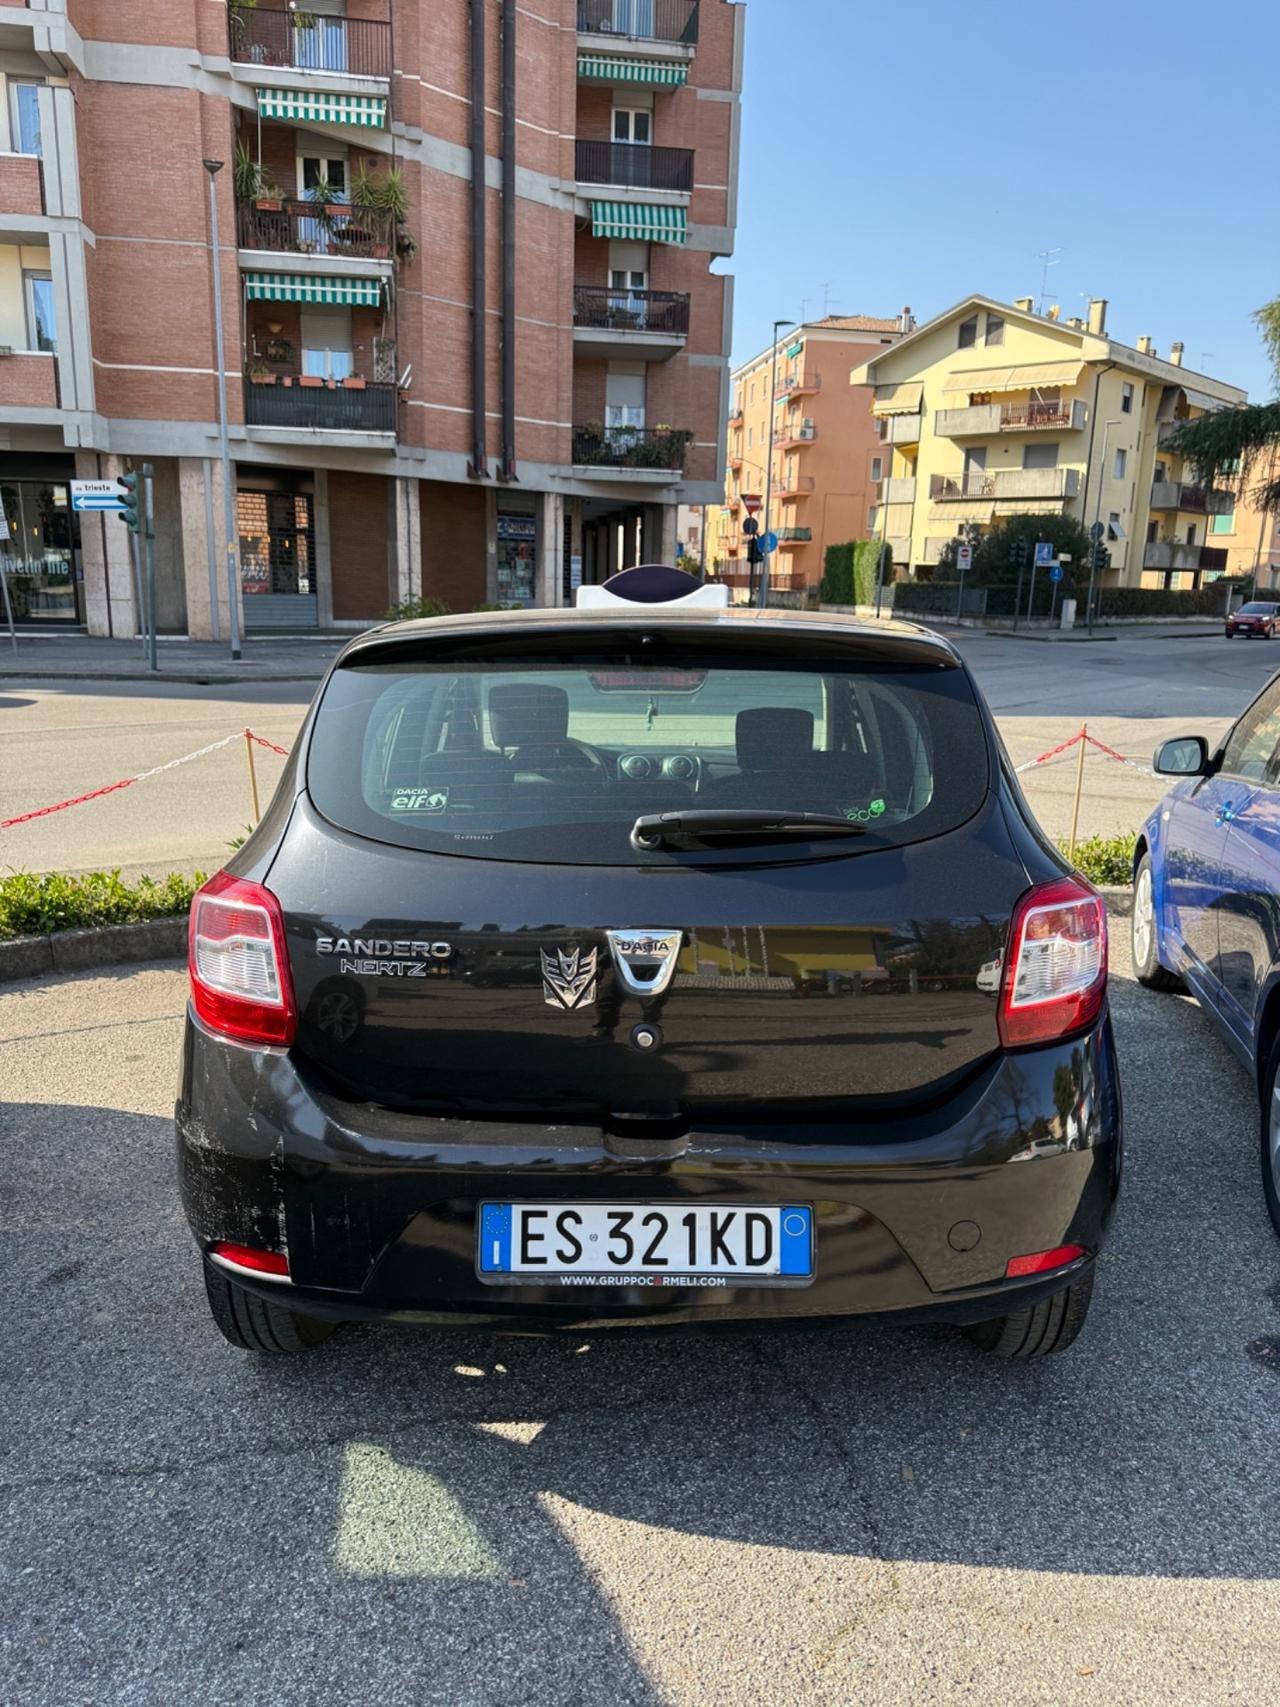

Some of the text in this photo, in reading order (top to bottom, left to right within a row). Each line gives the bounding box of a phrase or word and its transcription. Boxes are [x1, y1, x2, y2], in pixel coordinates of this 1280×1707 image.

[84, 484, 111, 492] trieste
[391, 795, 428, 809] elf
[316, 937, 452, 957] SANDERO
[621, 941, 669, 951] DACIA
[340, 958, 426, 977] HERTZ
[560, 1275, 726, 1287] WWW.GRUPPOCARMELI.COM
